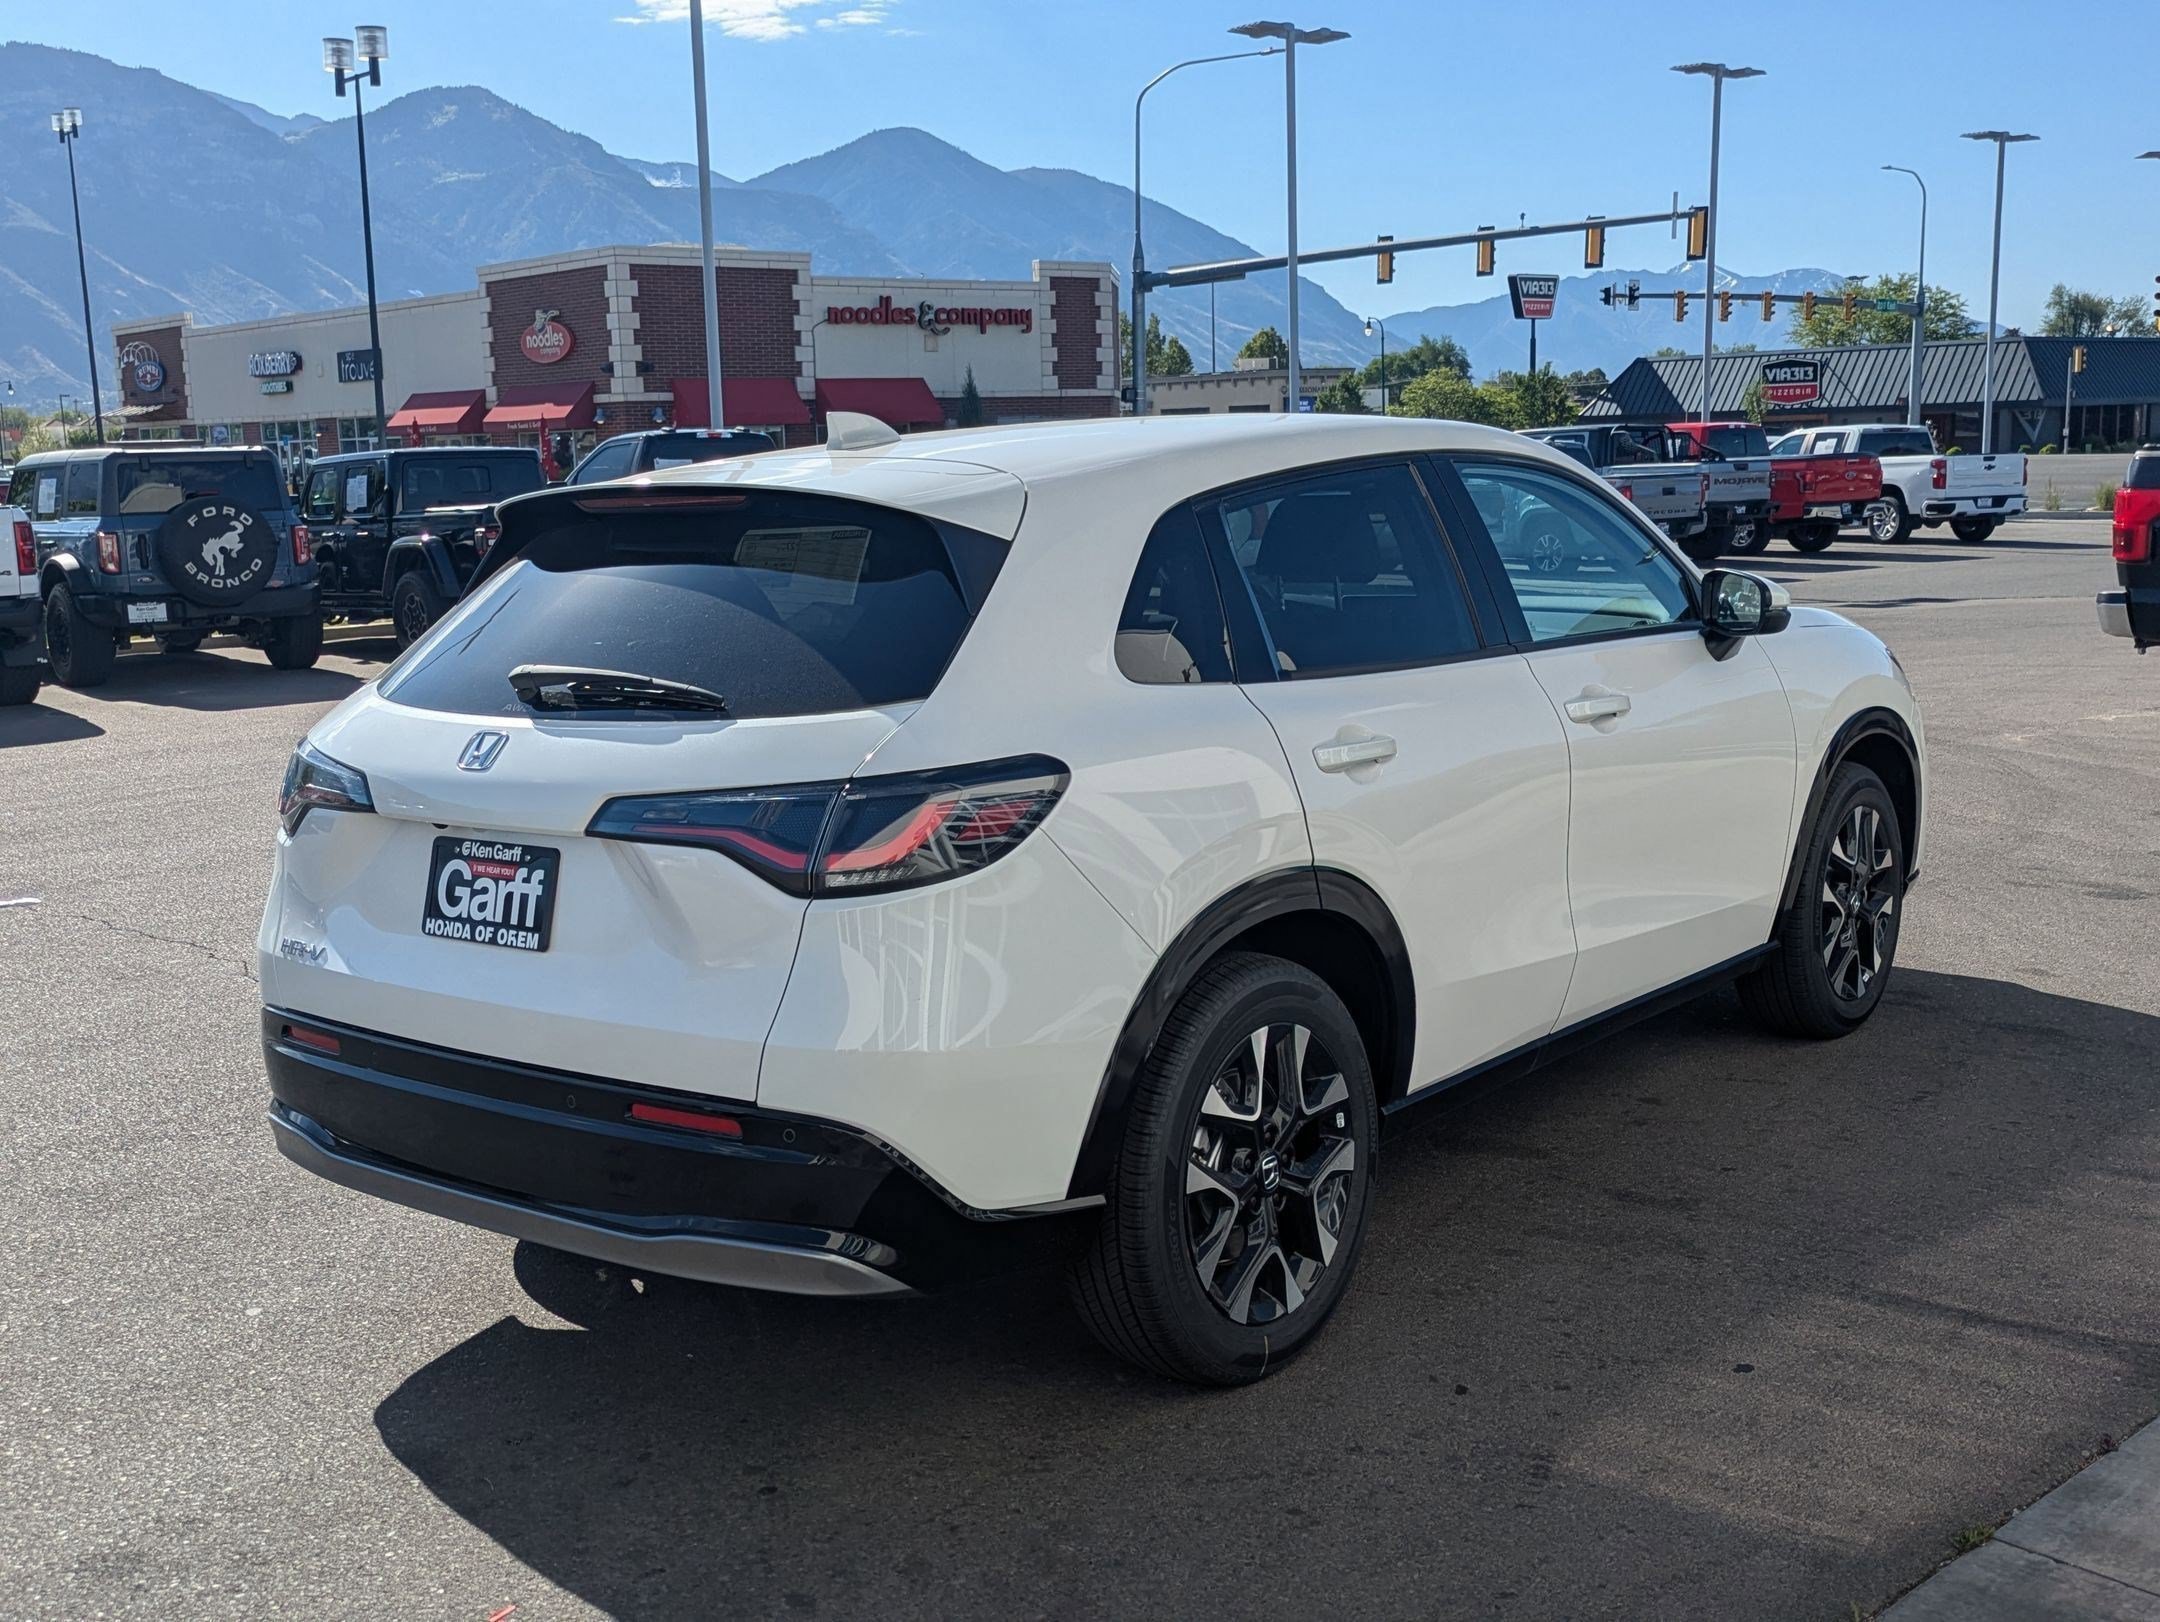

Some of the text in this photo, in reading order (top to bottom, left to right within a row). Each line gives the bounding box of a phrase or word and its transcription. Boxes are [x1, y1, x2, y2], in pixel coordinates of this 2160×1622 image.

[827, 295, 916, 325] noodles
[934, 307, 1033, 334] company
[526, 325, 564, 349] noodles
[249, 353, 291, 376] ROXBERRY
[1768, 387, 1812, 396] PIZZERIA
[1713, 477, 1766, 486] MOJAVE
[187, 506, 253, 527] FORD
[185, 558, 262, 588] BRONCO
[471, 842, 522, 862] Ken Garff
[477, 865, 512, 876] WE HEAR YOU
[438, 859, 545, 928] Garff
[425, 918, 540, 950] HONDA OF OREM
[281, 937, 327, 961] HR-V
